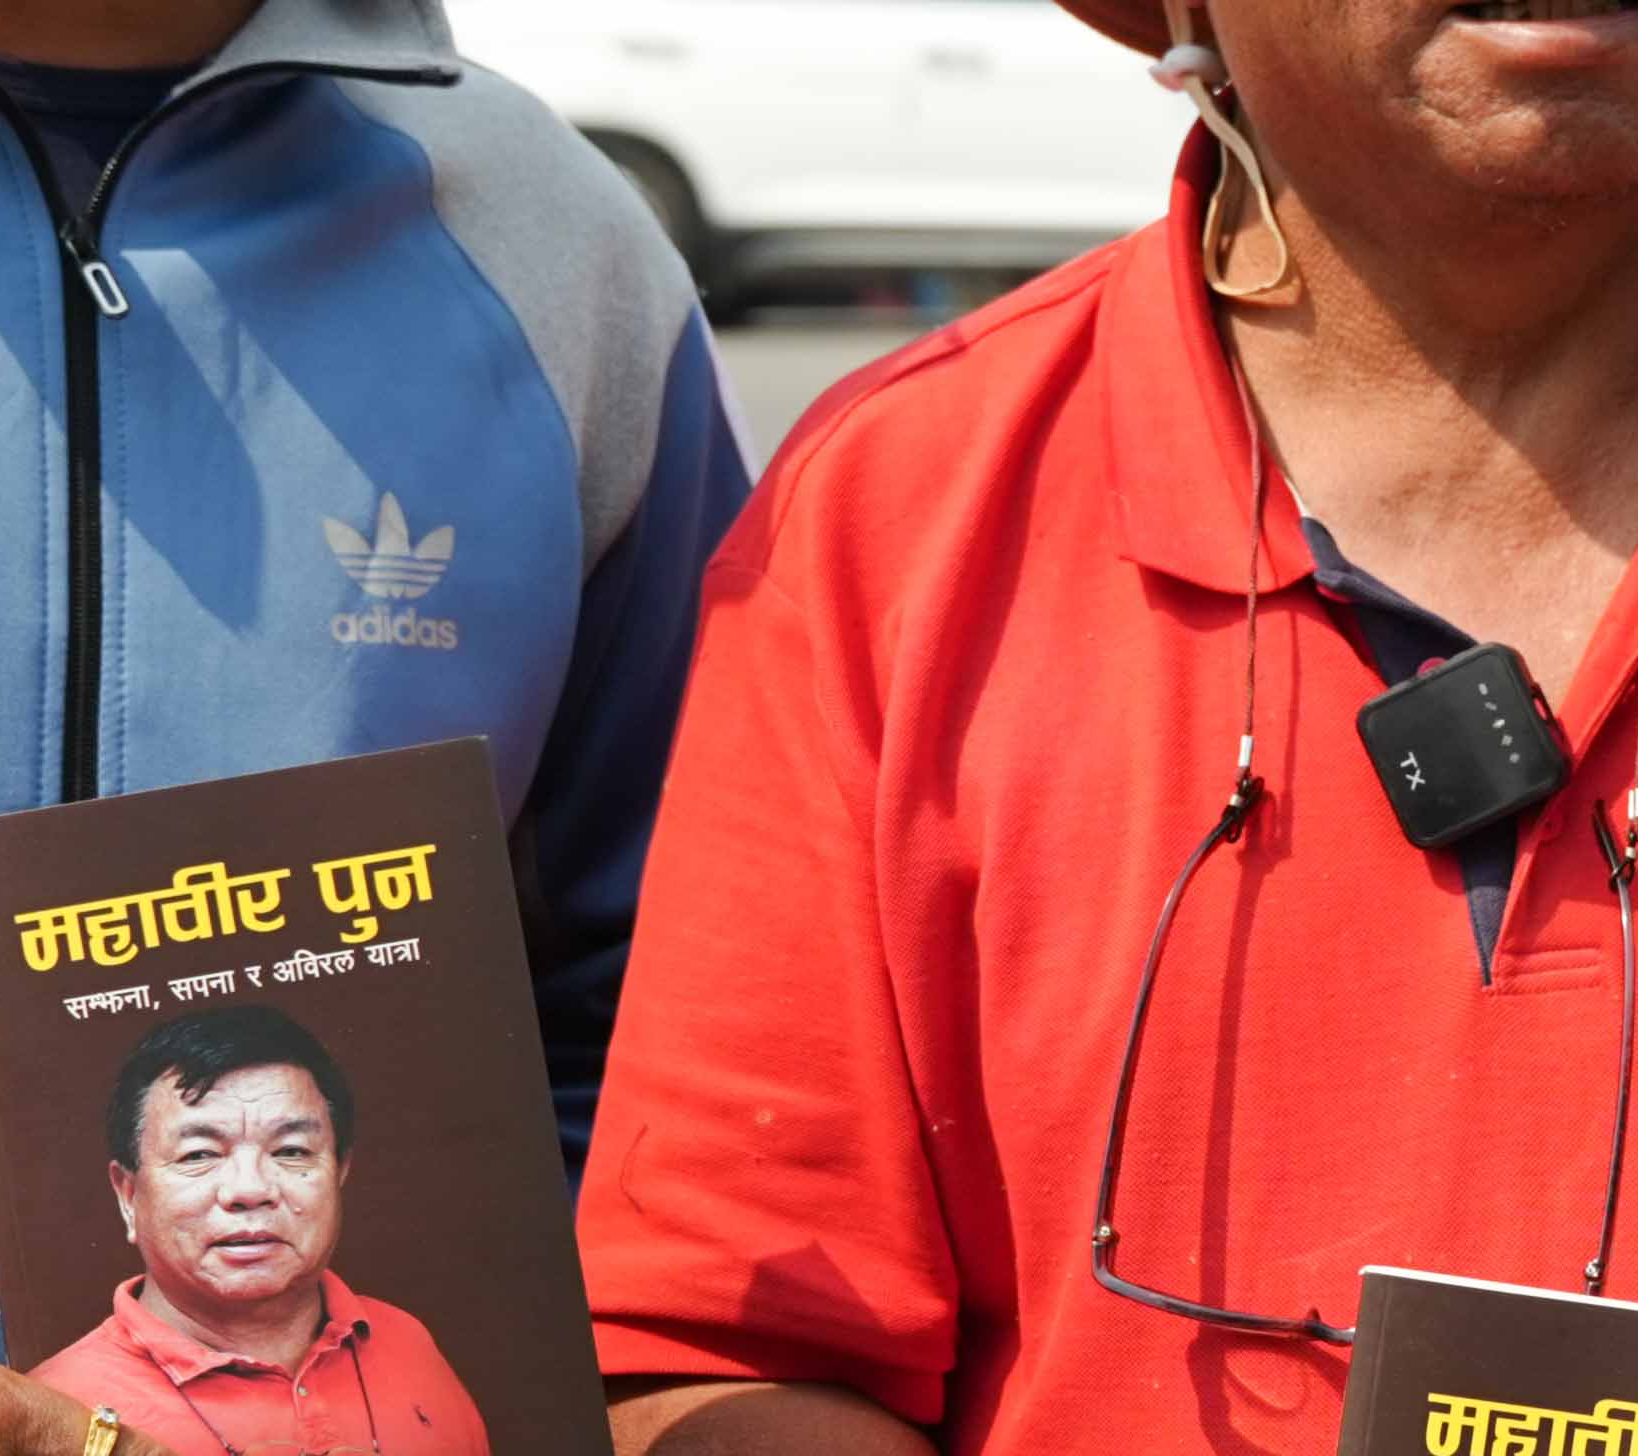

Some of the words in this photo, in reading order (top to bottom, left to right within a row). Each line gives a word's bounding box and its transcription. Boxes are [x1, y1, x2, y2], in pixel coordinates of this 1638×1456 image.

[329, 604, 458, 649] adidas
[1399, 750, 1427, 792] TX
[12, 860, 292, 973] महावीर
[310, 842, 438, 945] पुन
[61, 983, 161, 1021] सम्झना,
[166, 968, 236, 1002] सपना
[243, 964, 264, 989] र
[272, 947, 356, 984] अविरल
[362, 936, 422, 968] यात्रा
